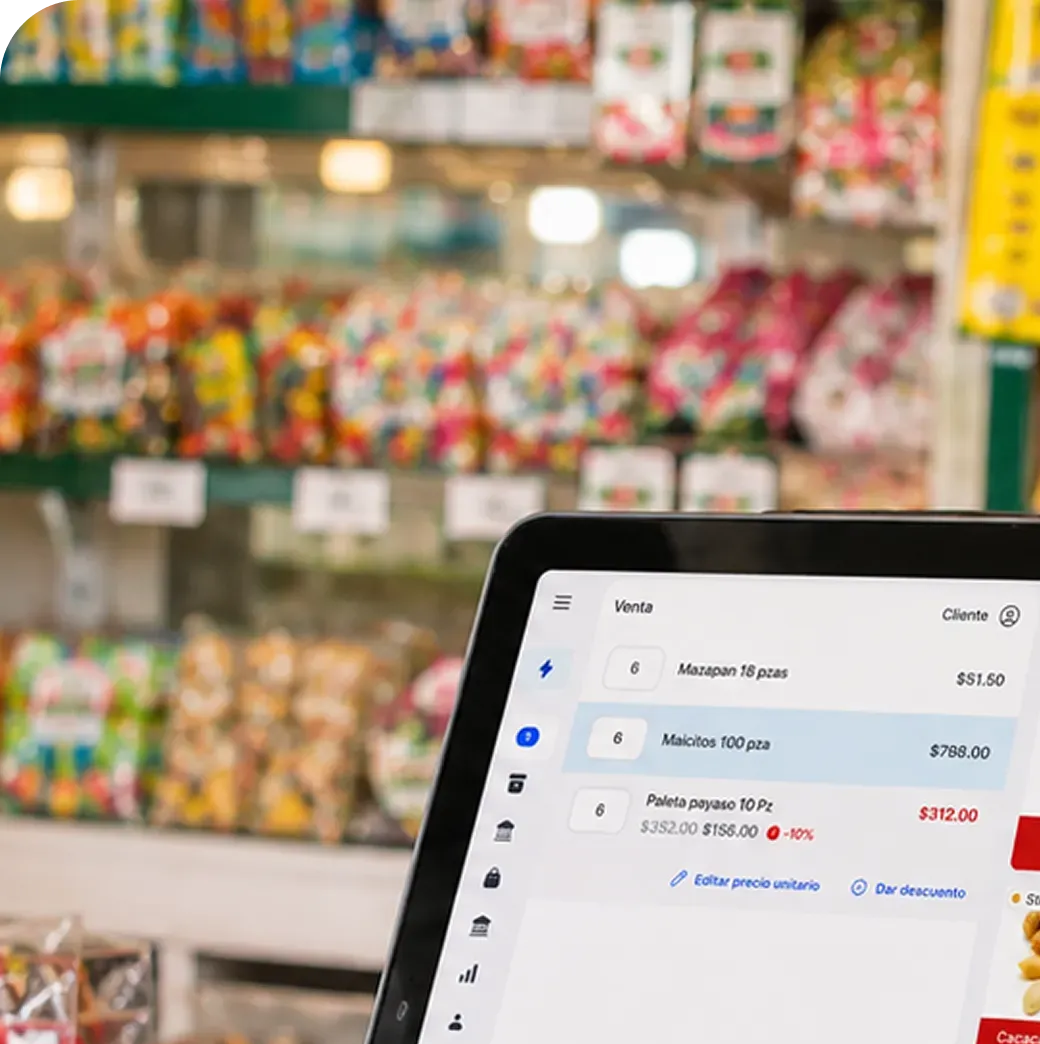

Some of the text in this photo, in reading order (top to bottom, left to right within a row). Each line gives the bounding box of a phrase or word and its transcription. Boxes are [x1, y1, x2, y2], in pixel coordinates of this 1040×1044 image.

[614, 598, 654, 614] Venta
[942, 607, 989, 623] Cliente
[630, 661, 640, 676] 6
[676, 662, 738, 680] Mazapan
[756, 667, 789, 681] pzas
[613, 730, 623, 746] 6
[661, 733, 771, 754] Maicitos 100 pza
[595, 803, 606, 818] 6
[645, 793, 774, 814] Paleta payaso 10 Pz
[918, 806, 979, 823] $312.00
[730, 876, 772, 892] precio
[773, 878, 821, 894] unitario
[874, 881, 898, 897] Dar
